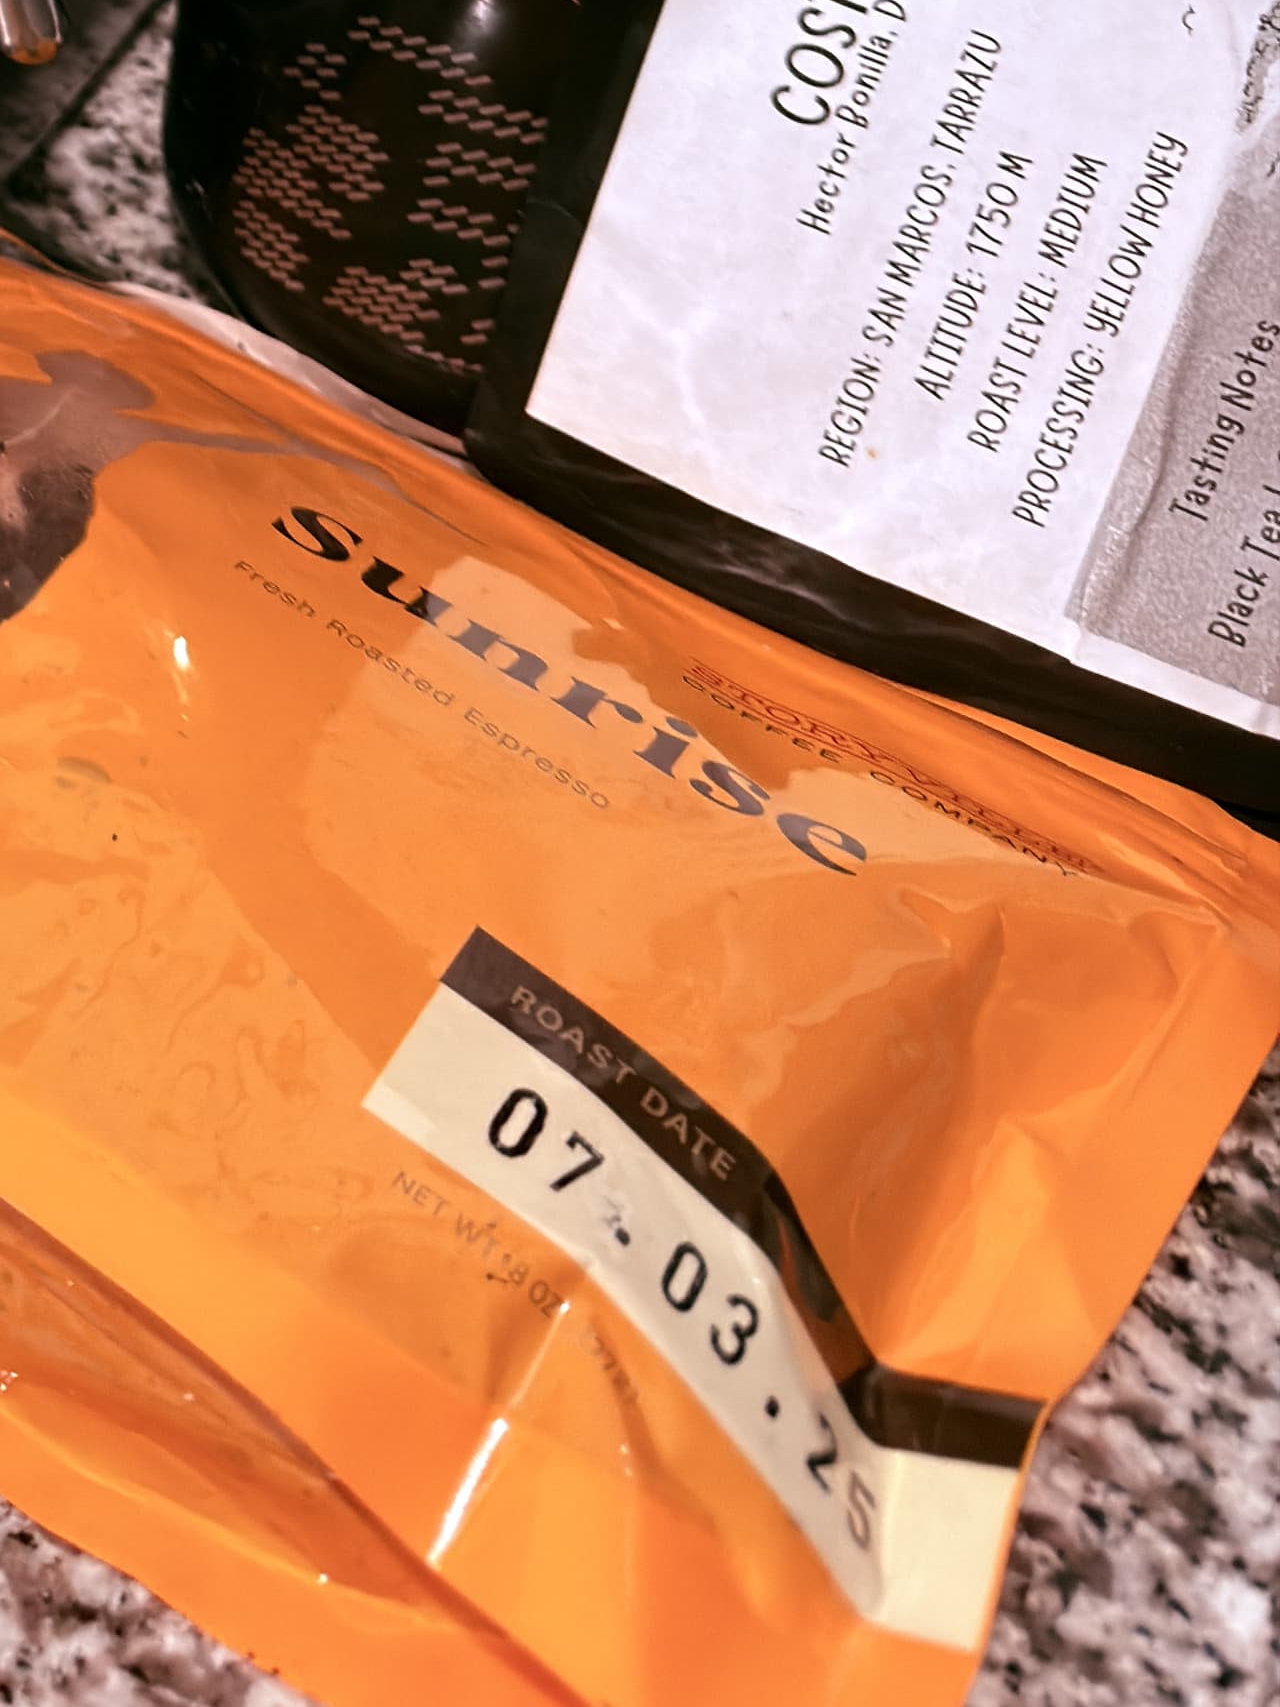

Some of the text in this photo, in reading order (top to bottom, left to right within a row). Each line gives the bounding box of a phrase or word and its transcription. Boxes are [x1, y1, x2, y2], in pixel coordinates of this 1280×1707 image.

[796, 132, 857, 236] Hector
[817, 352, 882, 468] REGION:
[862, 286, 908, 348] SAN
[930, 28, 1002, 155] TARRAZU
[914, 150, 1034, 401] ALTITUDE: 1750 M
[967, 152, 1108, 453] ROAST LEVEL: MEDIUM
[1011, 130, 1189, 529] PROCESSING: YELLOW HONEY
[1168, 320, 1280, 522] Tasting Notes
[234, 560, 611, 810] Fresh Roasted Espresso
[271, 505, 867, 876] Sunrise
[1207, 565, 1270, 649] Black
[681, 674, 1078, 877] COFFEE COMPANY
[391, 1170, 450, 1216] NET
[510, 985, 735, 1181] ROAST DATE
